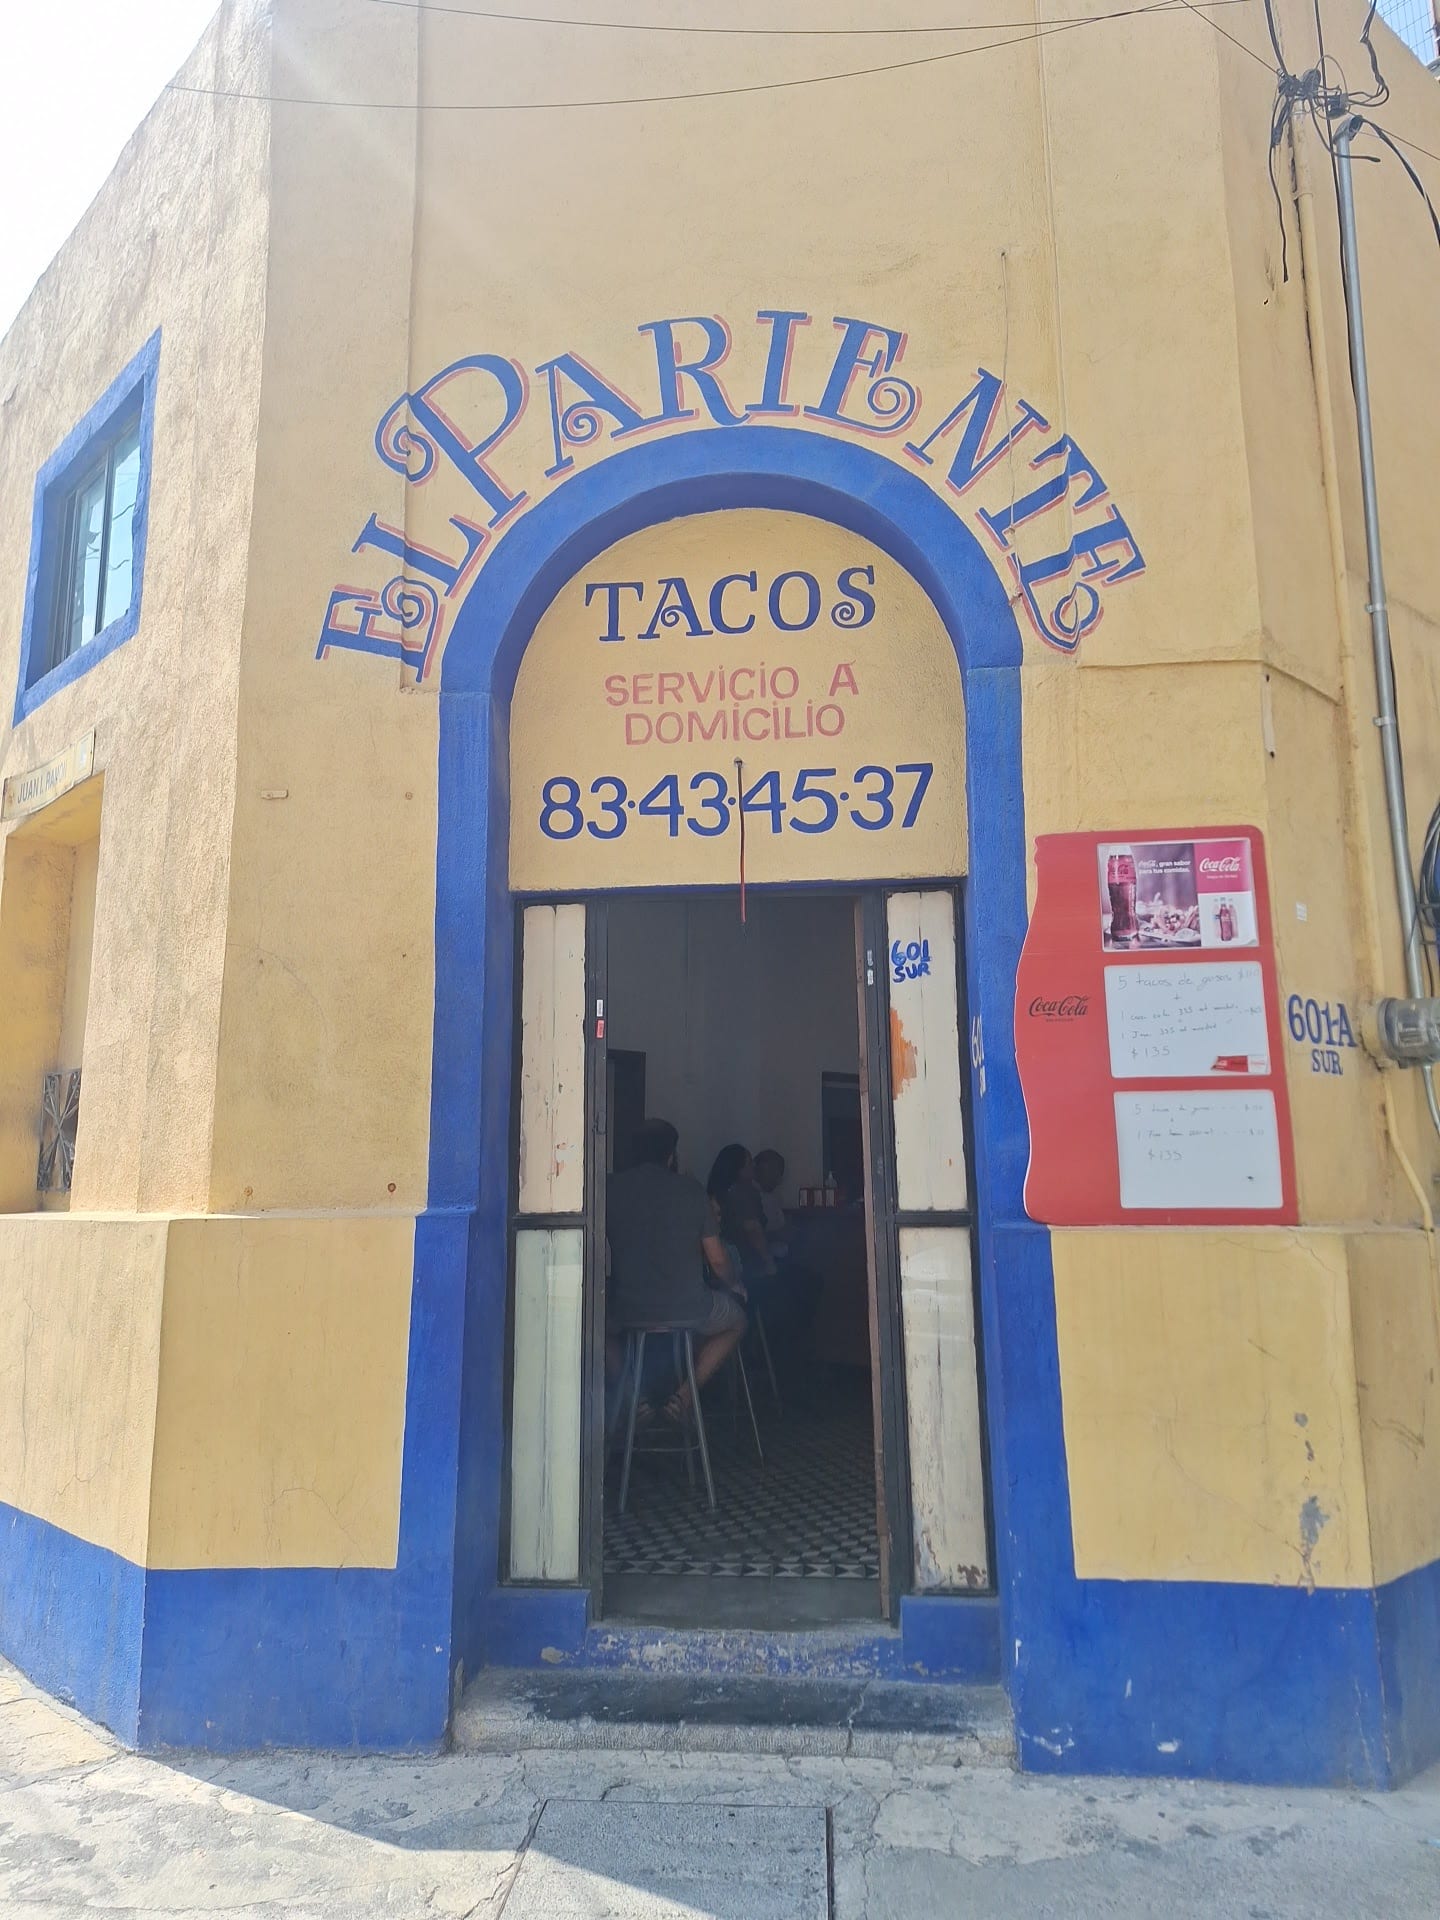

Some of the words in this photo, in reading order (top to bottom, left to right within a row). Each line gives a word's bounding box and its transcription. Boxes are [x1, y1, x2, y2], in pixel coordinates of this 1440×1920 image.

[374, 310, 1146, 656] PARIENTE
[315, 511, 492, 684] EL
[585, 564, 877, 642] TACOS
[17, 778, 40, 804] JUAN
[890, 939, 932, 966] 601
[893, 962, 931, 983] SUR
[1118, 975, 1128, 990] 5
[1135, 971, 1173, 987] tacos
[1178, 970, 1193, 986] de
[1029, 995, 1090, 1017] Coca-Cola
[1311, 1048, 1344, 1076] SUR
